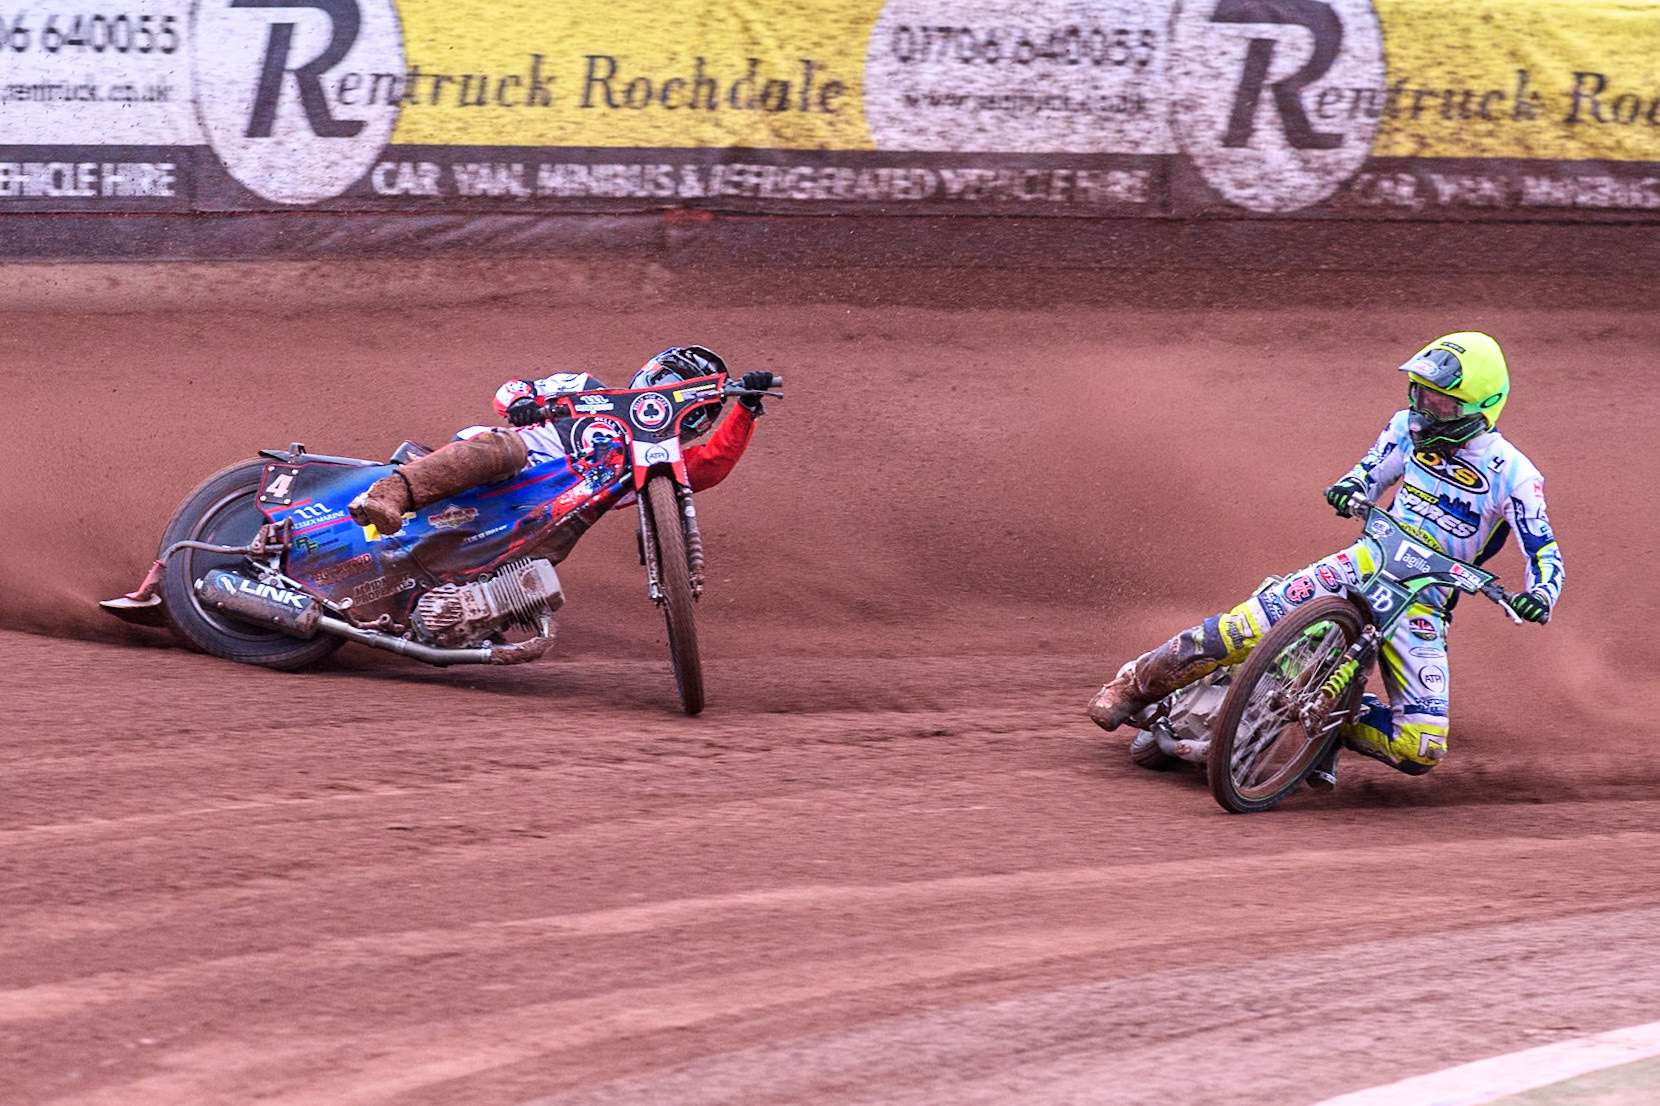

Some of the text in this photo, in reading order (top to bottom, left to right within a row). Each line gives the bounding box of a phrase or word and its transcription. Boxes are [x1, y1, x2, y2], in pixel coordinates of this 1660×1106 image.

[41, 14, 180, 54] 640055
[579, 54, 847, 114] Rochdale
[265, 473, 294, 498] 4
[1402, 552, 1431, 573] agilia
[239, 579, 307, 609] LINK
